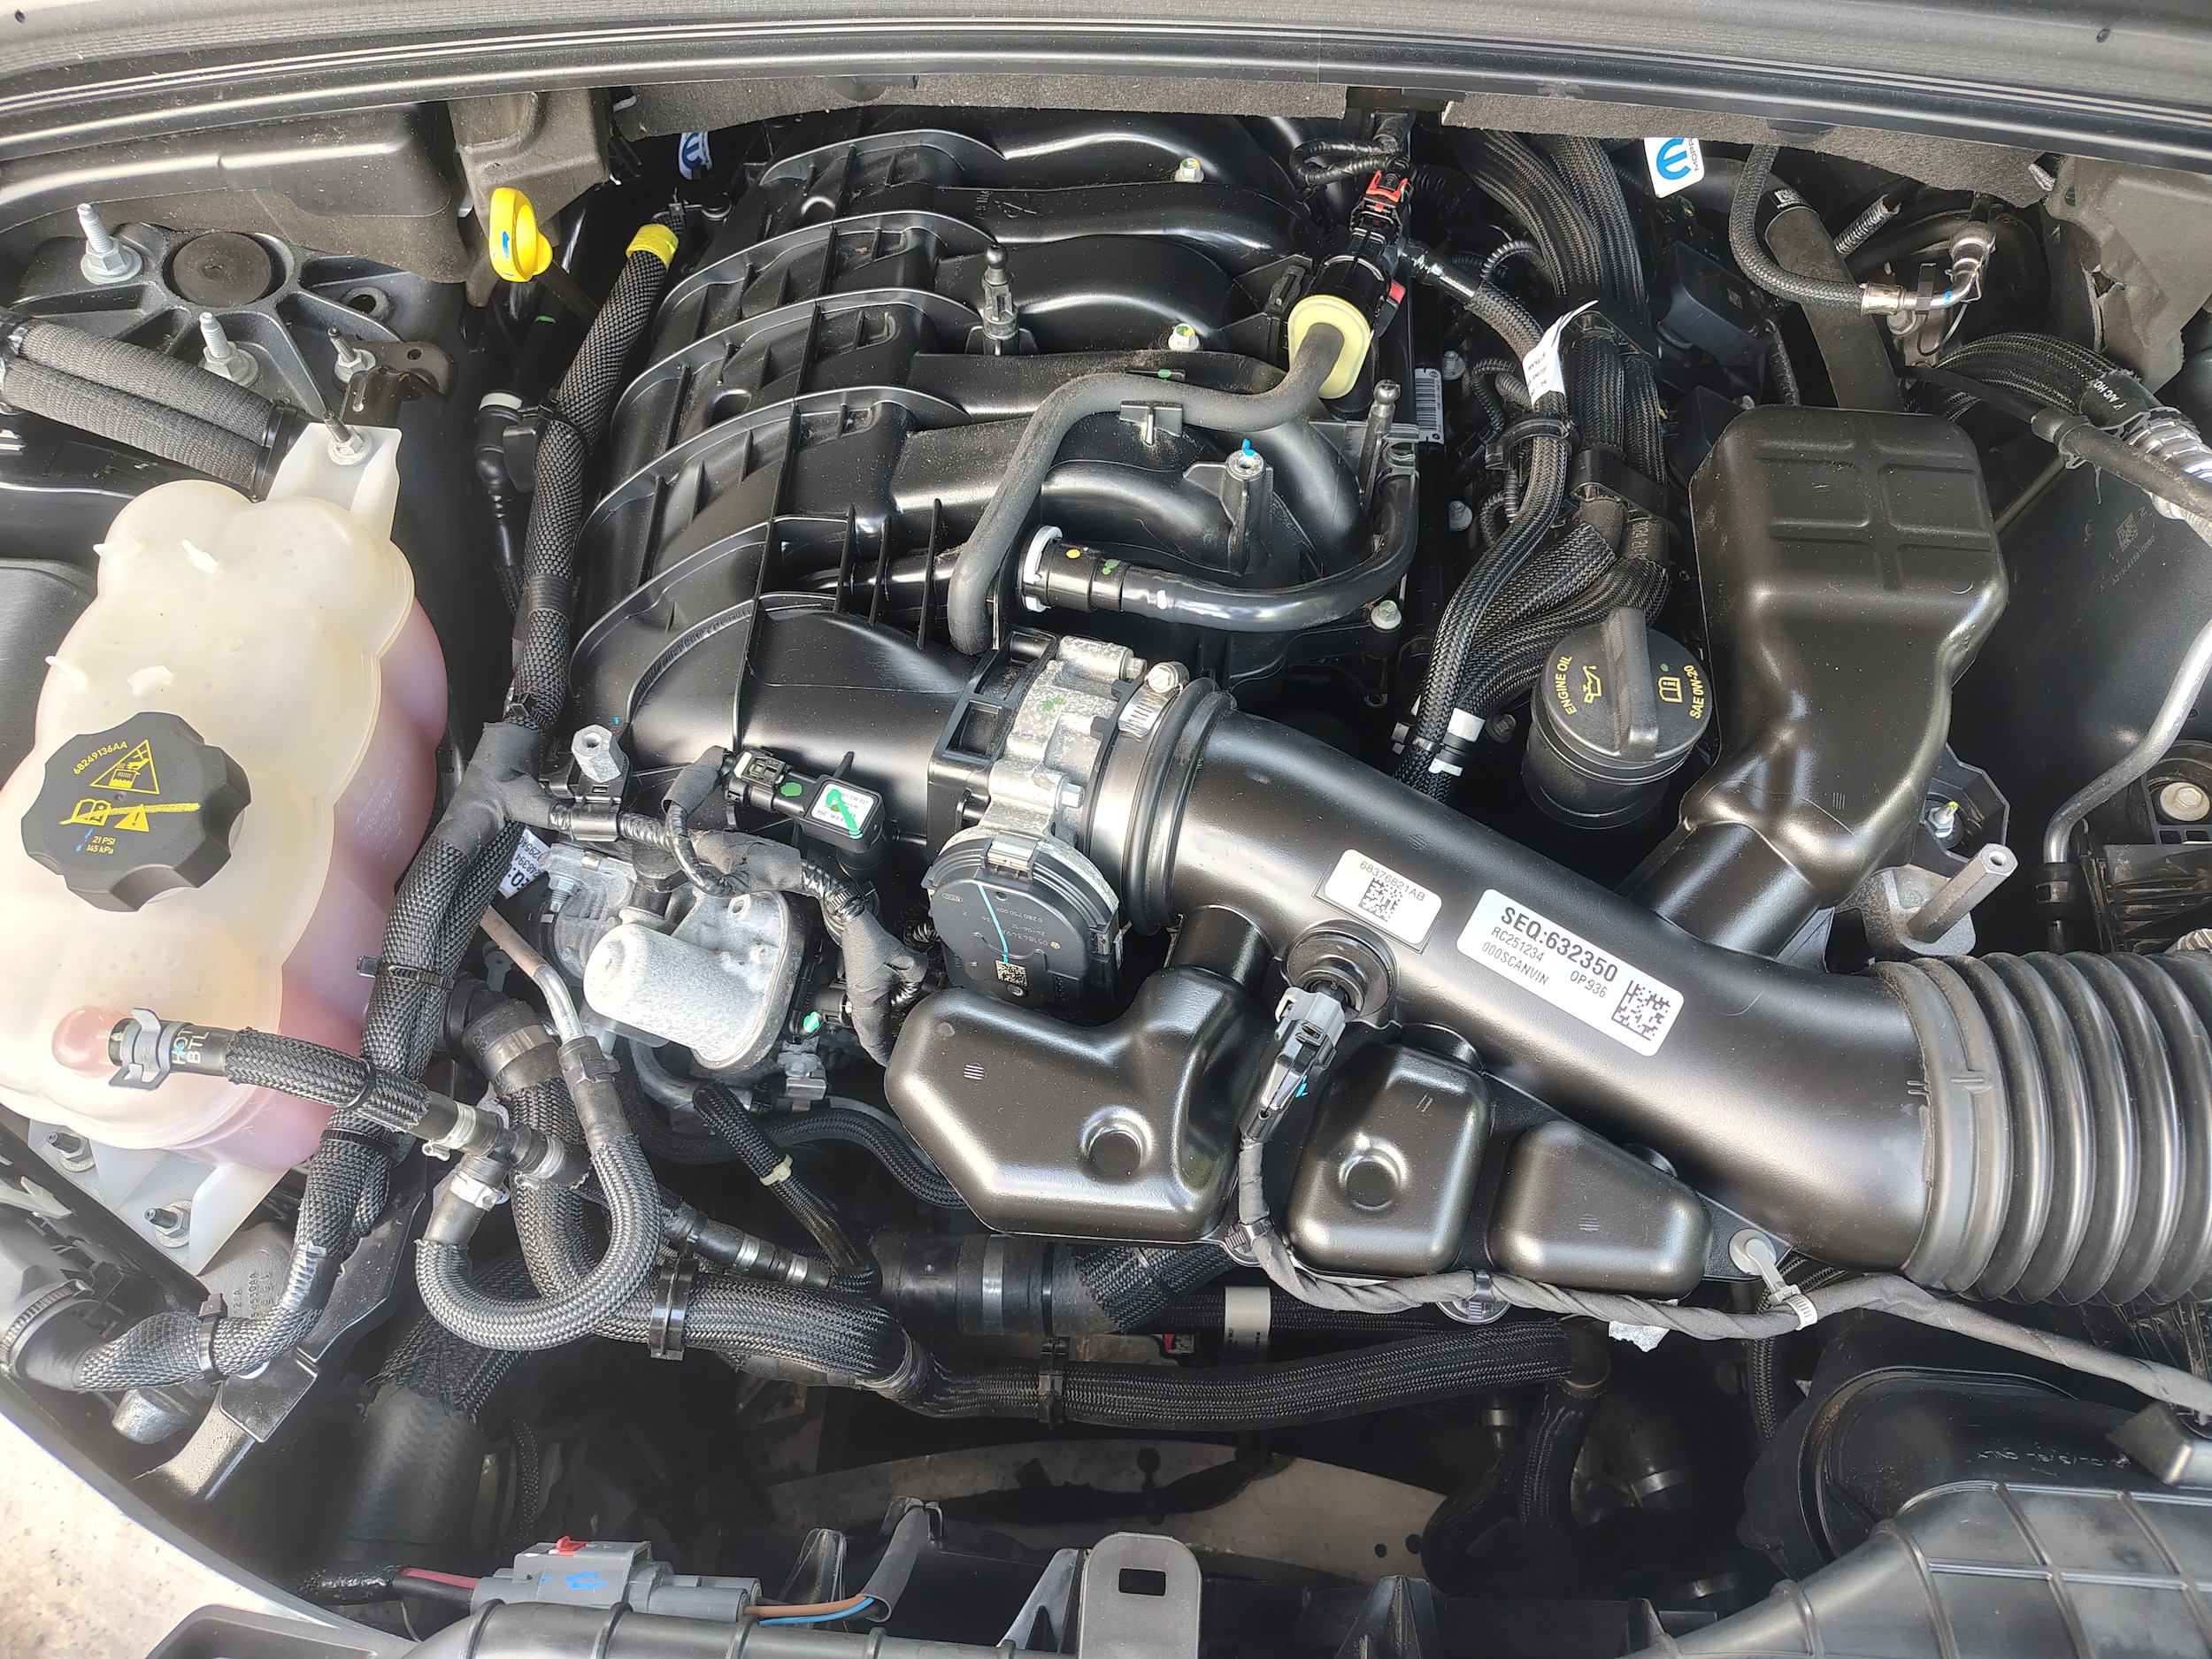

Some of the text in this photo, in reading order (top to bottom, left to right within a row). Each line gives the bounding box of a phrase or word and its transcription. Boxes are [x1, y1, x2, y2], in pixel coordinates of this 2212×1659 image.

[1555, 656, 1578, 716] ENGINE OIL
[1683, 664, 1705, 719] SAE 0W-20
[73, 741, 128, 775] 68249136AA
[87, 844, 114, 855] 145 kPa
[92, 835, 103, 844] 21
[1359, 861, 1425, 902] 68376821AB
[1491, 926, 1546, 963] RC251234
[1501, 906, 1619, 983] SEQ:632350
[172, 1028, 193, 1064] HOT
[188, 1031, 210, 1064] BTL
